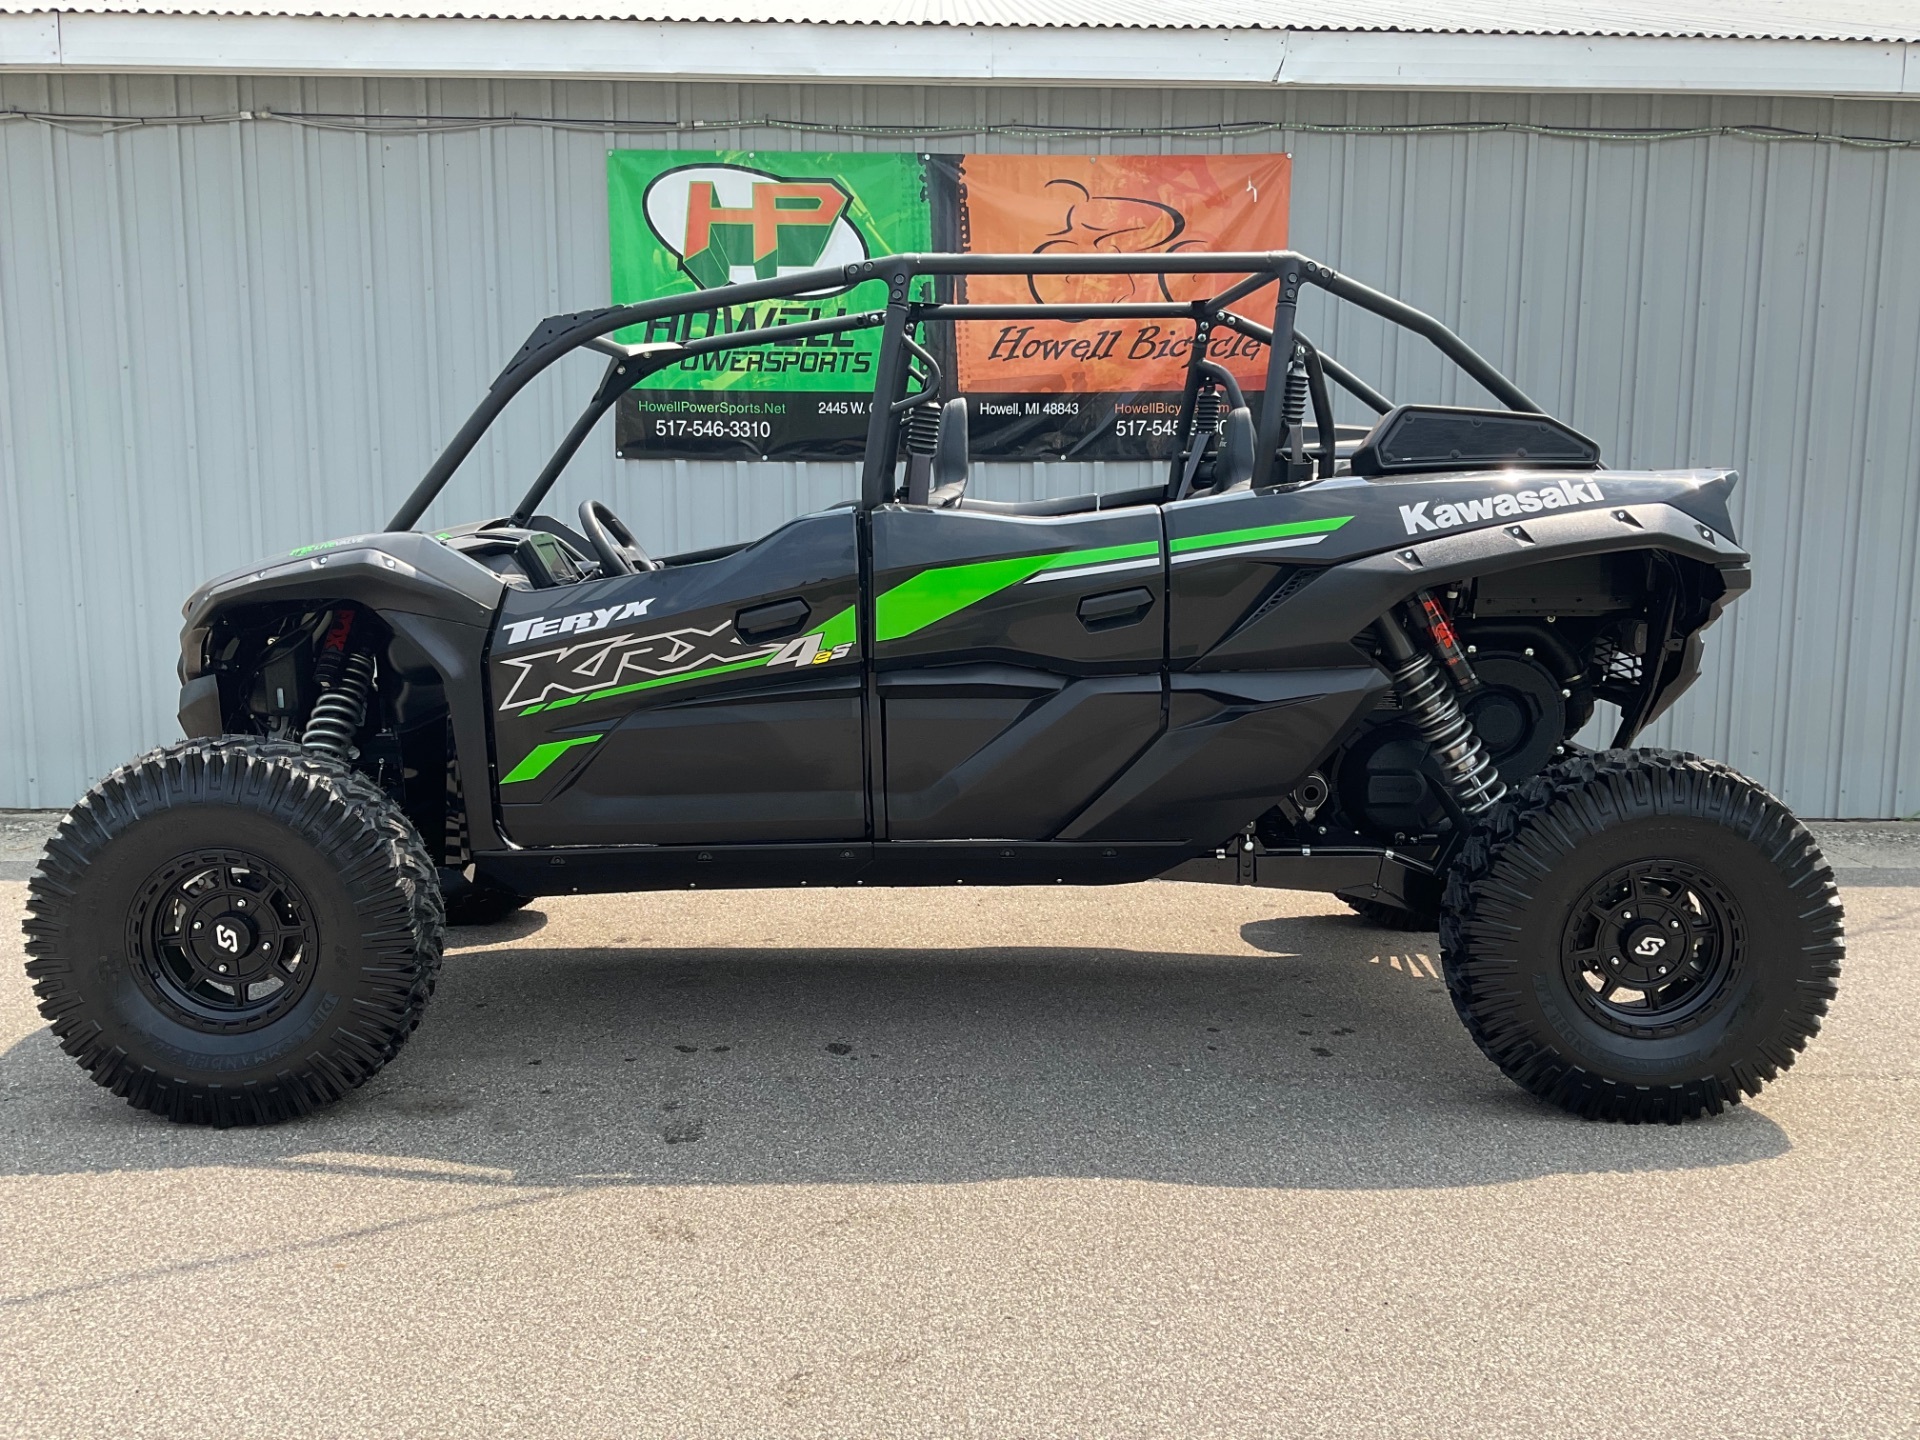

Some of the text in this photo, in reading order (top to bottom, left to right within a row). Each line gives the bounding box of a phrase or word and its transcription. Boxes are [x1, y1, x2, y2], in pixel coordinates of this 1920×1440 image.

[644, 307, 855, 347] HOWELL
[988, 325, 1262, 369] Howell Biccle
[660, 351, 873, 374] OWERSPORTS
[638, 400, 786, 416] HowellPowerSports.Net
[818, 402, 848, 415] 2445
[850, 402, 866, 415] W.
[980, 402, 1079, 417] Howell, MI 48843
[1115, 402, 1229, 416] HowellBicym
[655, 420, 771, 438] 517-546-3310
[1115, 420, 1228, 437] 517-545
[1399, 477, 1605, 535] Kawasaki
[502, 597, 656, 645] TERYX
